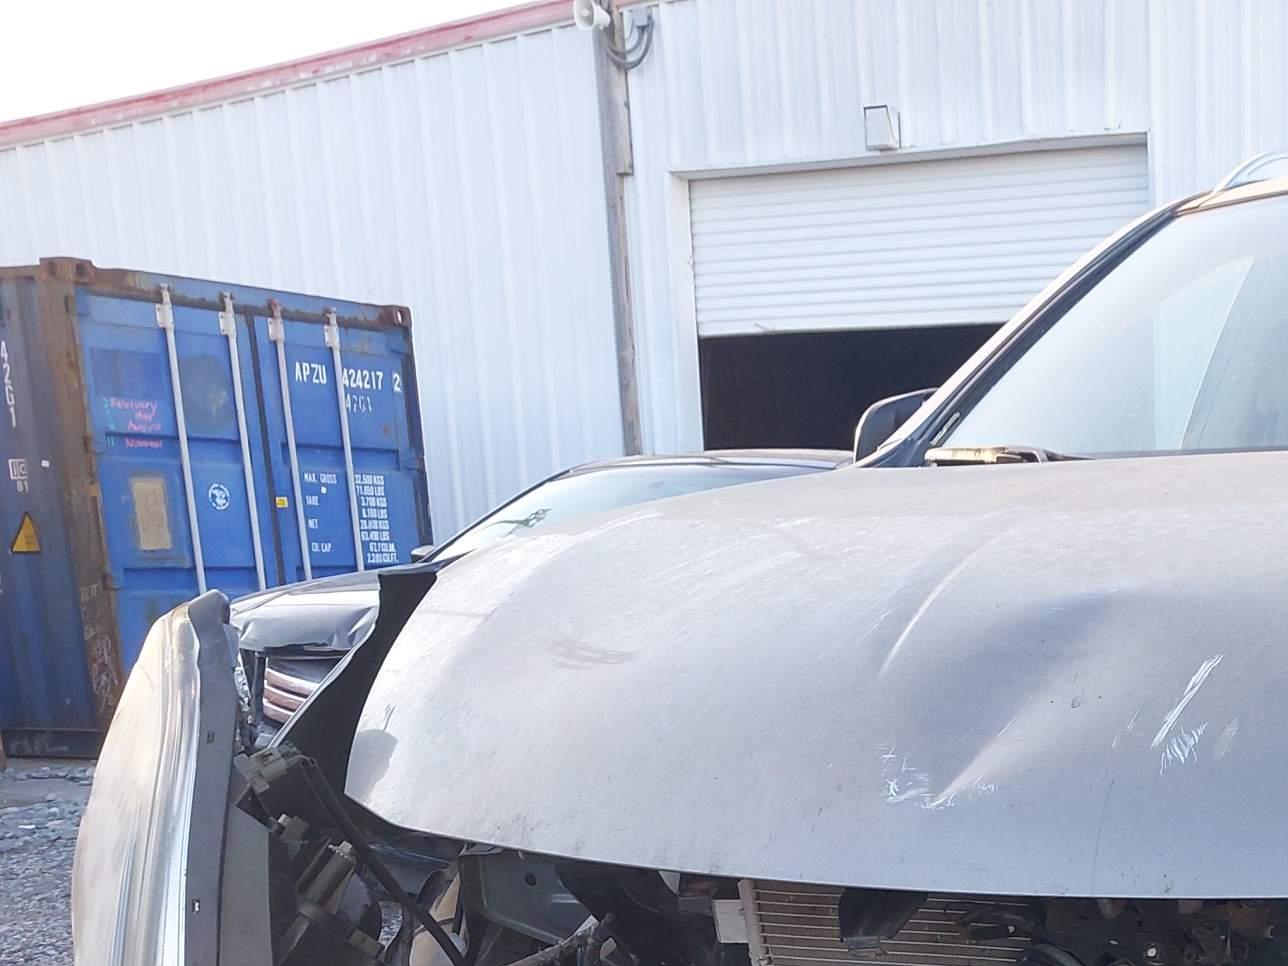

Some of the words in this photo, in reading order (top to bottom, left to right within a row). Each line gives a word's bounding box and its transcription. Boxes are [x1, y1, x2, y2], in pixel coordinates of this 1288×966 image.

[0, 340, 17, 428] 42G1
[295, 361, 327, 384] APZU
[342, 368, 383, 390] 424217
[392, 372, 402, 392] 2
[308, 519, 318, 529] NET
